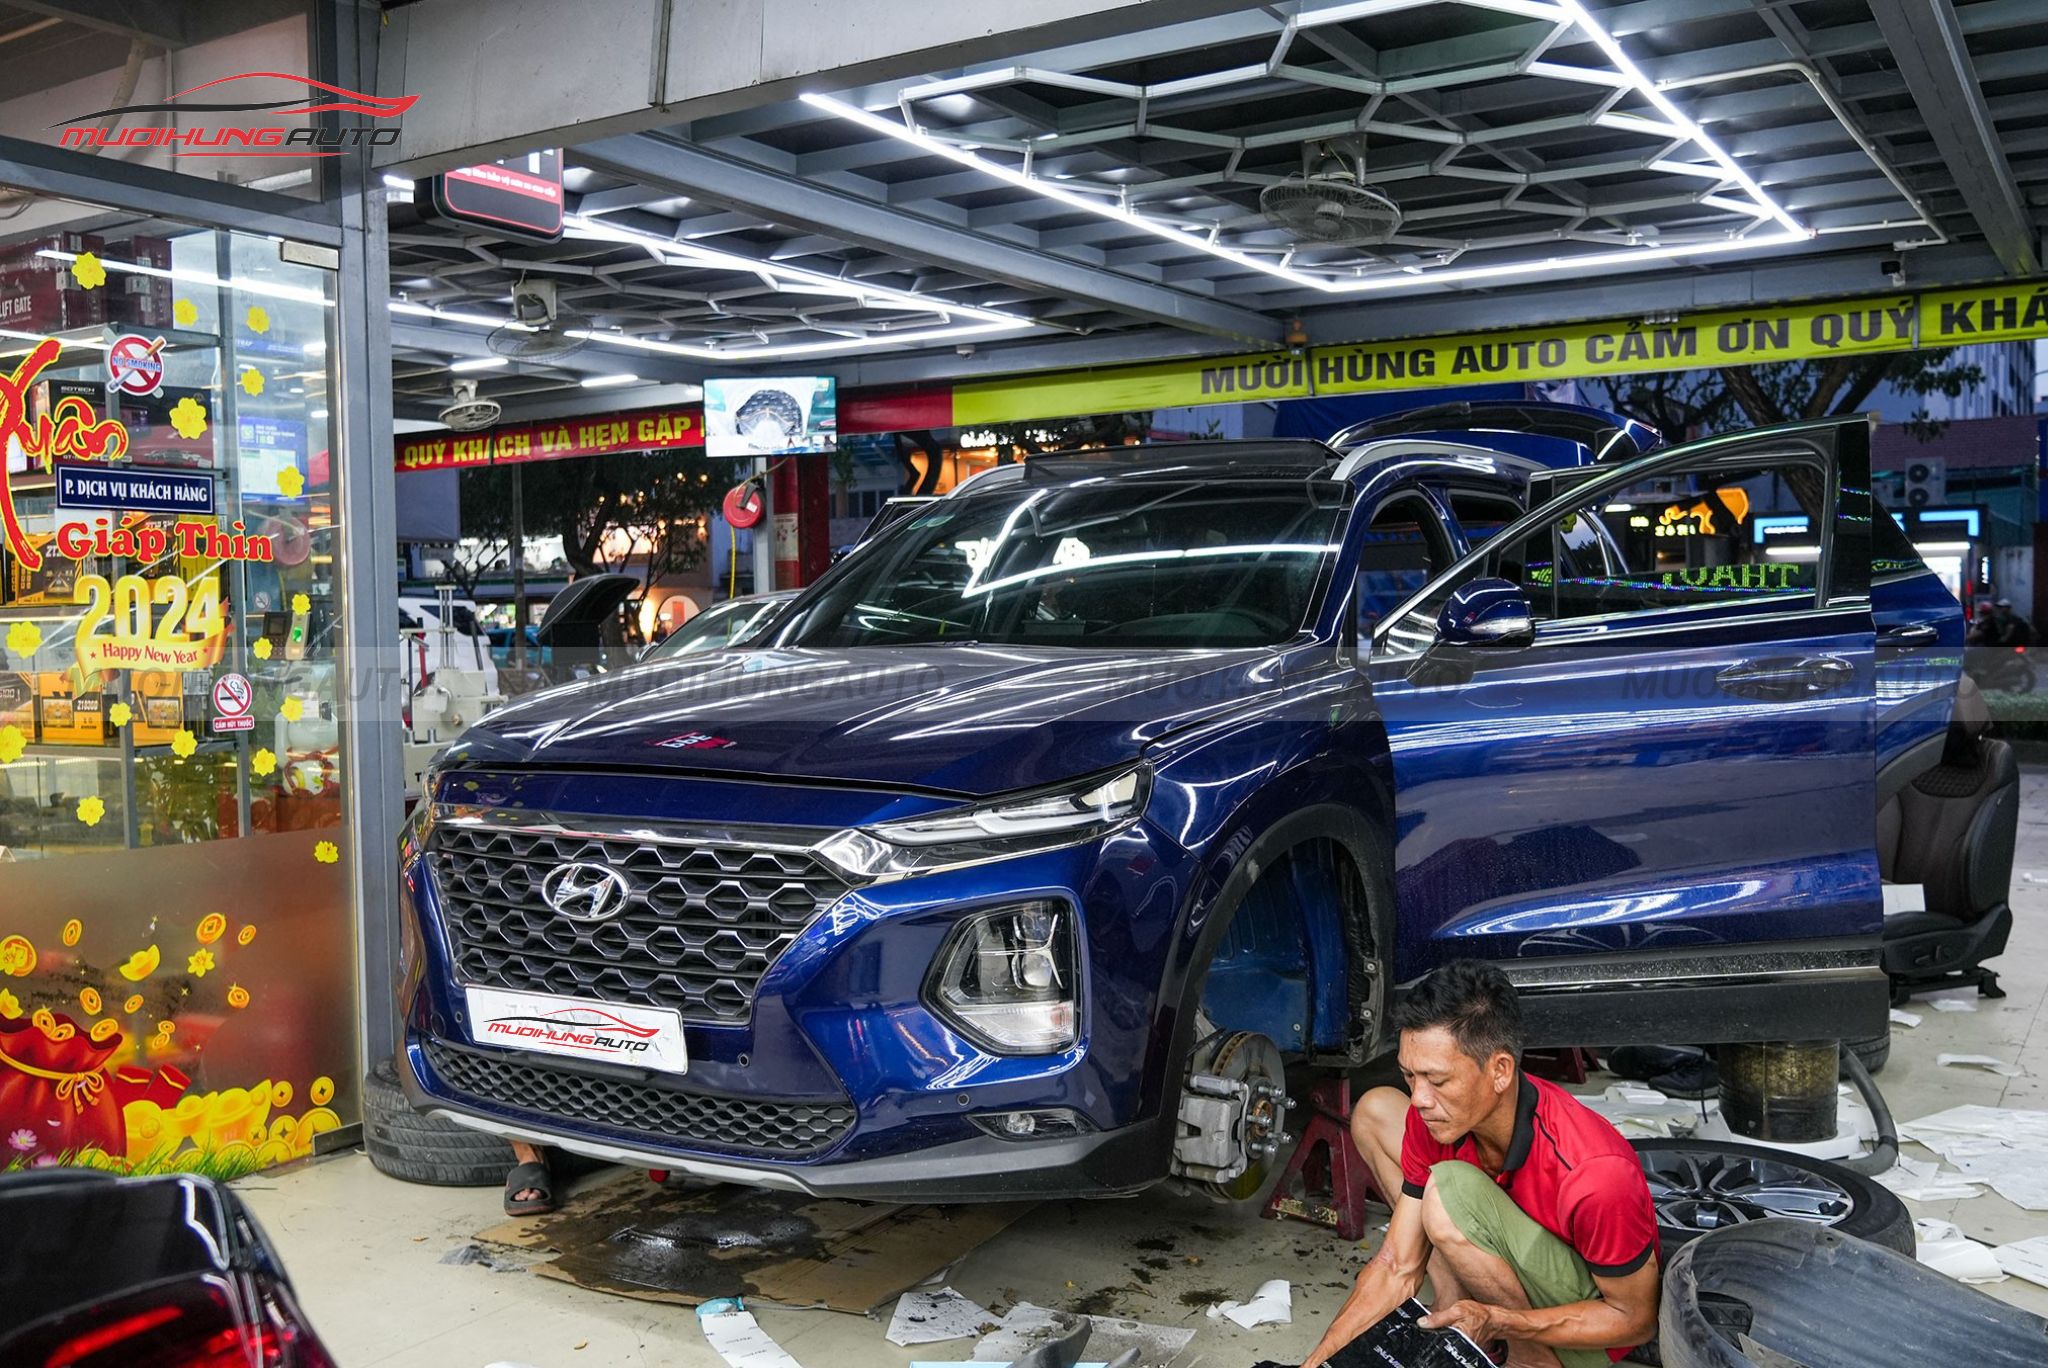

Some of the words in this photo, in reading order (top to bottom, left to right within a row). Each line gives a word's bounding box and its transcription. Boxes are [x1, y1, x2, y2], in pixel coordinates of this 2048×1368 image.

[14, 295, 32, 315] GATE
[1201, 355, 1303, 394] MƯỜI
[1319, 347, 1435, 385] HÙNG
[1451, 338, 1567, 375] AUTO
[1585, 320, 1697, 365] CẢM
[1717, 318, 1790, 353] ƠN
[1811, 300, 1915, 348] QUÝ
[113, 355, 124, 366] NO
[126, 358, 161, 372] SMOKING
[541, 424, 572, 452] VÀ
[579, 421, 630, 452] HẸN
[637, 411, 692, 446] GẶP
[65, 479, 75, 495] P.
[77, 480, 107, 500] DỊCH
[110, 482, 127, 502] VỤ
[130, 479, 171, 502] KHÁCH
[174, 481, 208, 503] HÀNG
[57, 518, 167, 564] Giáp
[175, 520, 274, 562] Thìn
[73, 575, 226, 643] 2024
[103, 643, 142, 662] Happy
[144, 645, 173, 664] New
[173, 650, 198, 664] Year
